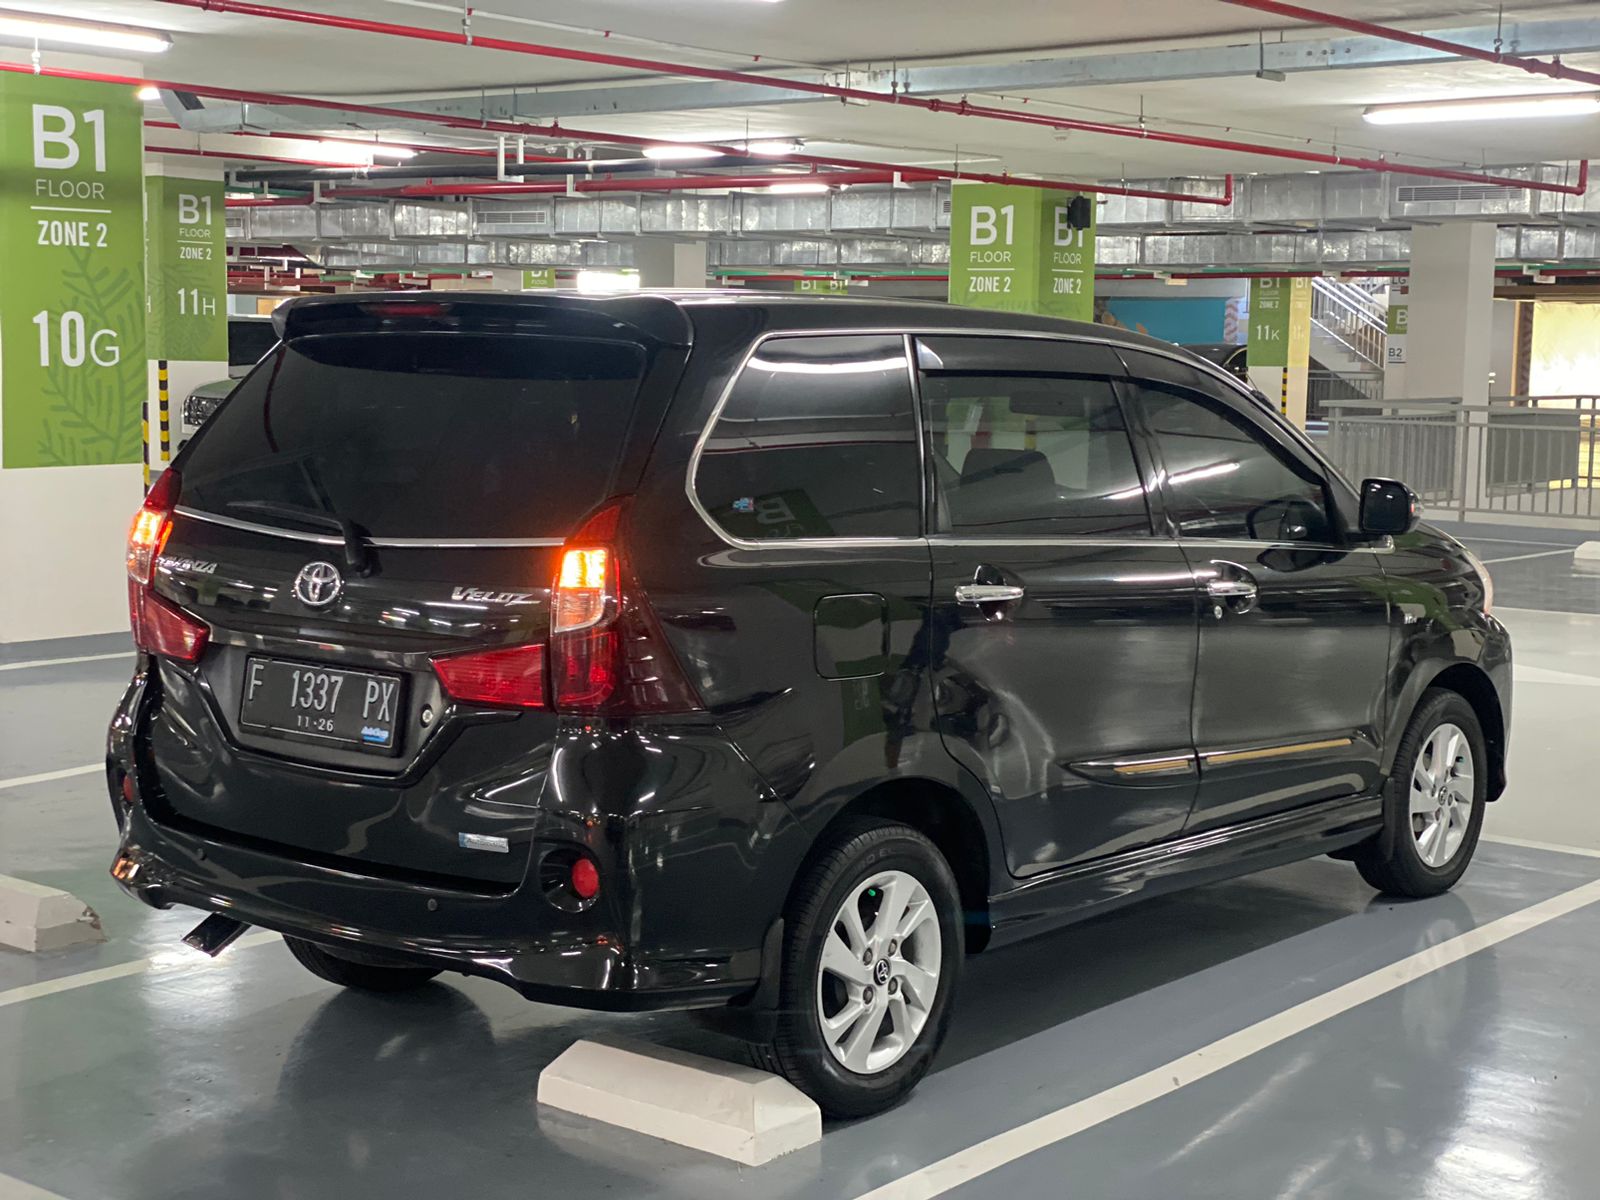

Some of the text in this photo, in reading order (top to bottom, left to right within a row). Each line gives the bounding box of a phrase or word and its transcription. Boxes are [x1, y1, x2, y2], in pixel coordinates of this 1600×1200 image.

[32, 103, 107, 172] B1
[35, 178, 105, 200] FLOOR
[178, 193, 212, 225] B1
[37, 219, 108, 248] ZONE 2
[179, 228, 211, 239] FLOOR
[969, 204, 1015, 246] B1
[179, 247, 212, 260] ZONE 2
[970, 251, 1012, 263] FLOOR
[1053, 252, 1082, 265] FLOOR
[969, 276, 1011, 293] ZONE 2
[1053, 278, 1082, 294] ZONE 2
[177, 287, 216, 316] 11H
[32, 310, 120, 368] 10G
[1256, 324, 1280, 341] 11K
[1388, 347, 1402, 357] B2
[248, 663, 395, 722] F 1337 PX
